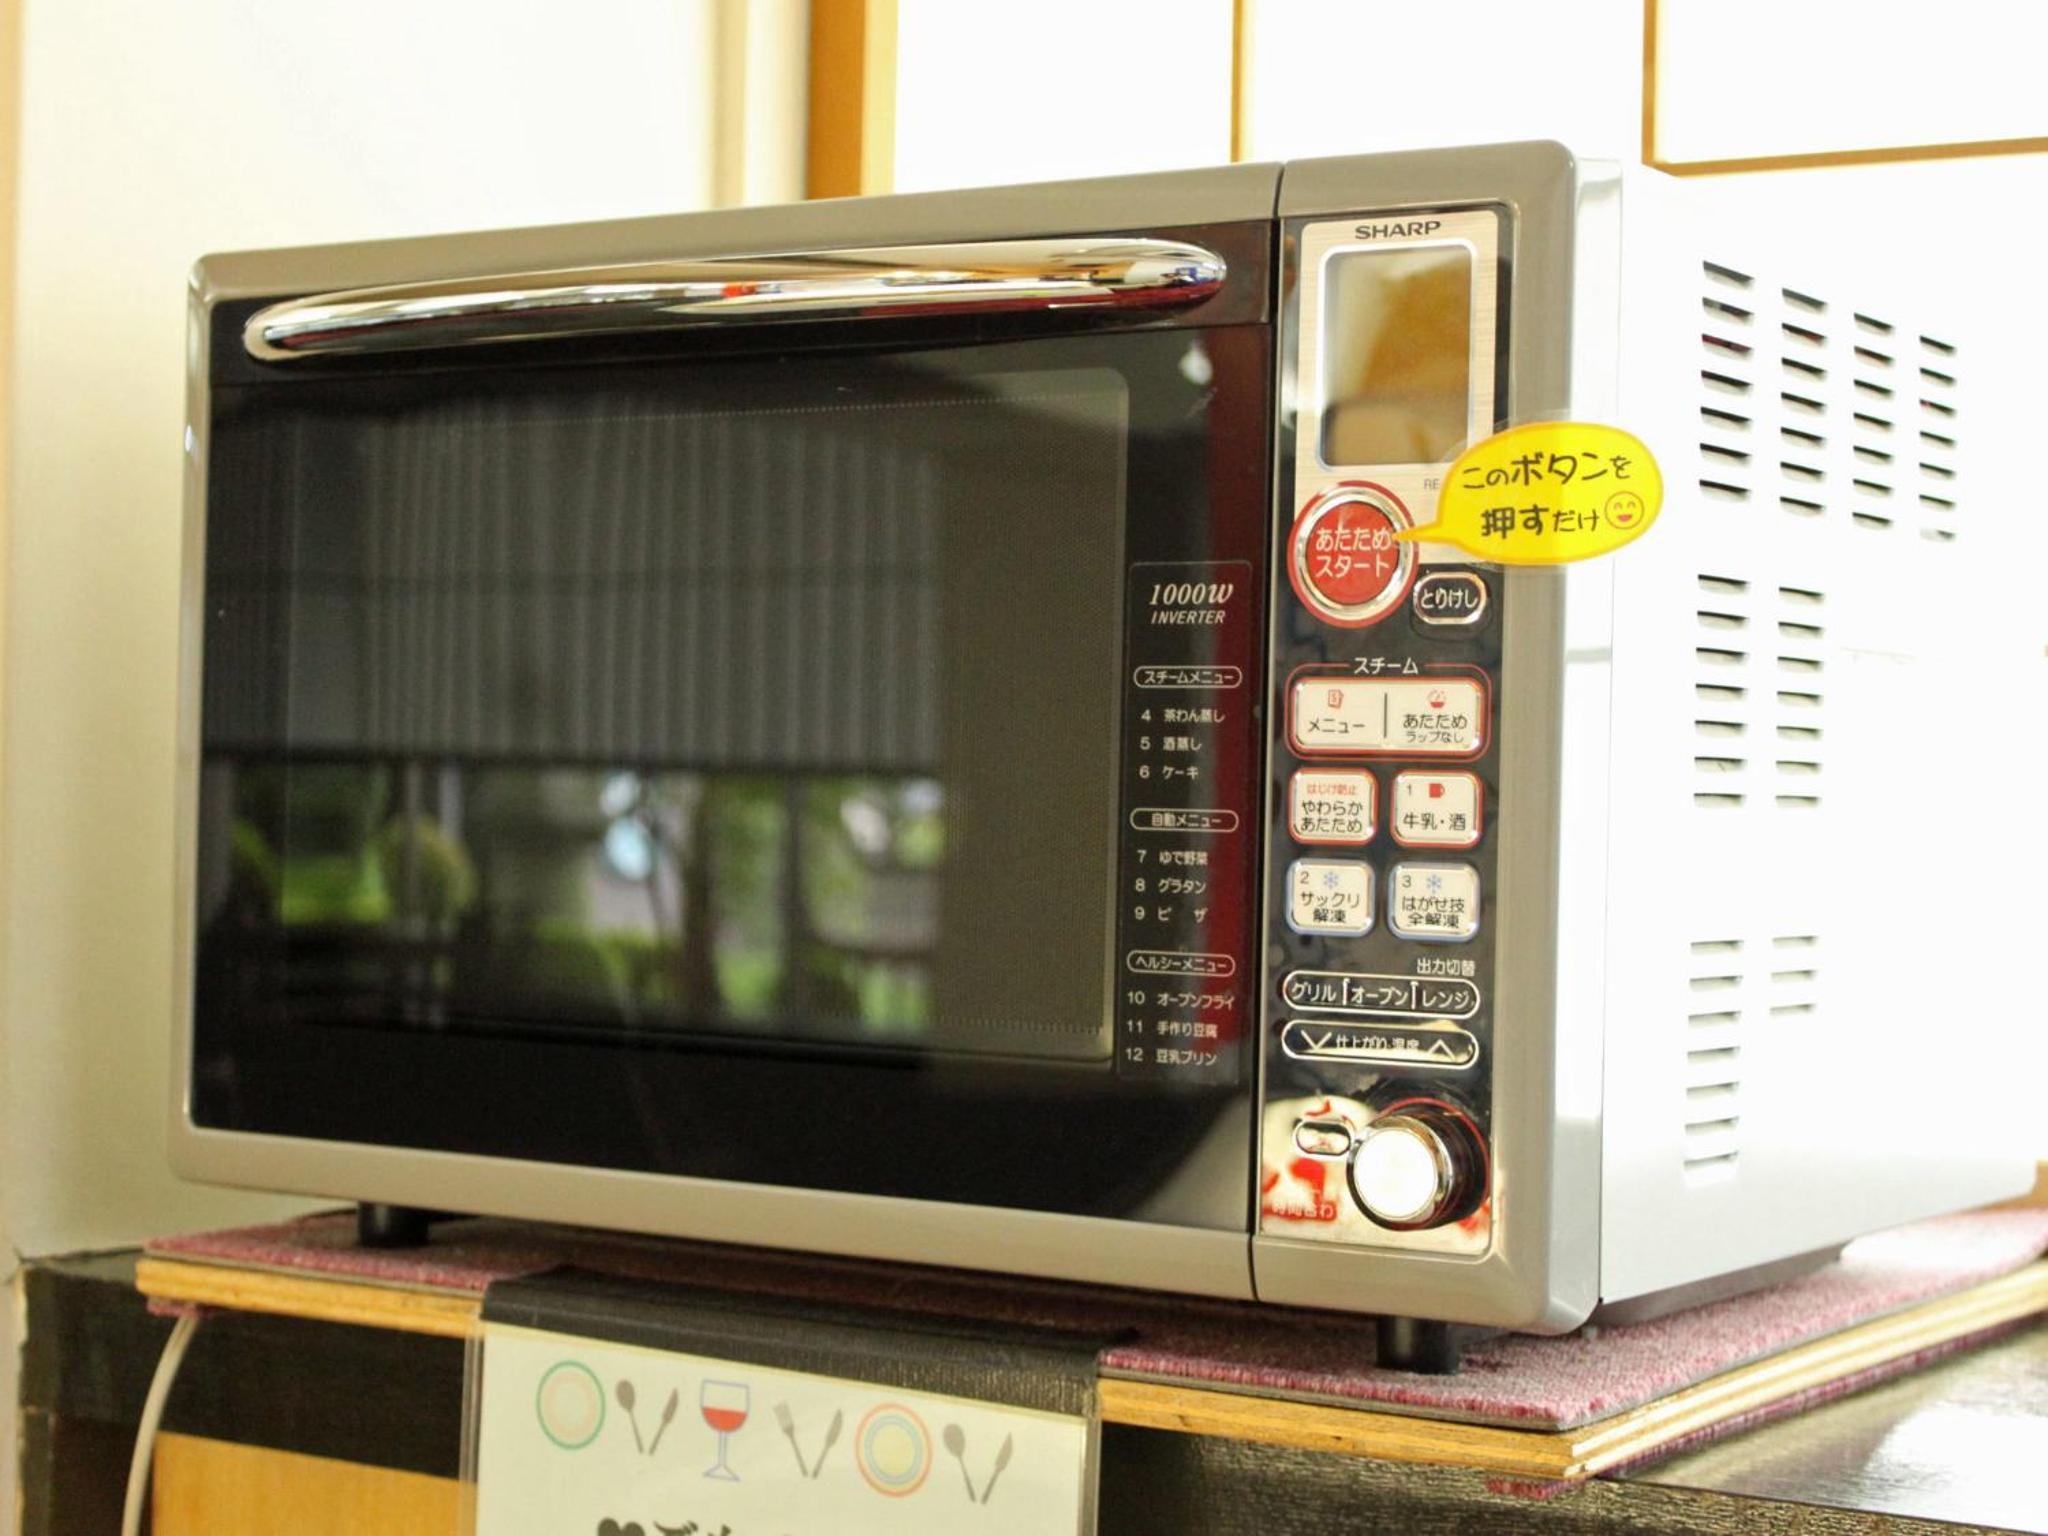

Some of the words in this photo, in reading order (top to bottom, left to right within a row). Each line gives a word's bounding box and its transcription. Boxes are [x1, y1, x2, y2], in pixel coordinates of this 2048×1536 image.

[1355, 220, 1441, 240] SHARP
[1463, 452, 1632, 490] このボタンを
[1481, 504, 1600, 539] 押すだけ
[1315, 527, 1392, 551] あたため
[1315, 554, 1390, 578] スタート
[1149, 583, 1234, 606] 1000W
[1420, 588, 1478, 609] とりけし
[1151, 610, 1226, 624] INVERTER
[1353, 657, 1419, 674] スチーム
[1144, 670, 1234, 684] スチームメニュー
[1141, 709, 1151, 722] 4
[1164, 709, 1226, 723] 茶わん蒸し
[1402, 714, 1468, 730] あたため
[1308, 717, 1366, 734] メニュー
[1140, 737, 1150, 750] 5
[1405, 731, 1464, 743] ラップなし
[1139, 765, 1150, 779] 6
[1162, 765, 1199, 780] ケーキ
[1406, 785, 1412, 796] 1
[1301, 800, 1363, 817] やわらか
[1151, 812, 1222, 827] 自動メニュー
[1300, 816, 1362, 833] あたため
[1402, 812, 1467, 831] 牛乳・酒
[1137, 850, 1147, 863] 7
[1159, 851, 1208, 865] ゆで野菜
[1135, 878, 1146, 892] 8
[1158, 877, 1207, 893] グラタン
[1300, 871, 1309, 884] 2
[1402, 875, 1412, 888] 3
[1300, 891, 1361, 909] サックリ
[1402, 896, 1465, 914] はがせ技
[1134, 906, 1145, 920] 9
[1313, 908, 1347, 923] 解凍
[1408, 912, 1460, 929] 全解凍
[1135, 956, 1227, 973] ヘルシーメニュー
[1416, 957, 1476, 977] 出力切替
[1127, 991, 1146, 1005] 10
[1157, 992, 1235, 1011] オープンフライ
[1291, 982, 1338, 1002] グリル
[1351, 985, 1409, 1004] オープン
[1422, 990, 1471, 1010] レンジ
[1126, 1020, 1143, 1033] 11
[1125, 1048, 1144, 1062] 12
[1156, 1048, 1218, 1066] 豆乳プリン
